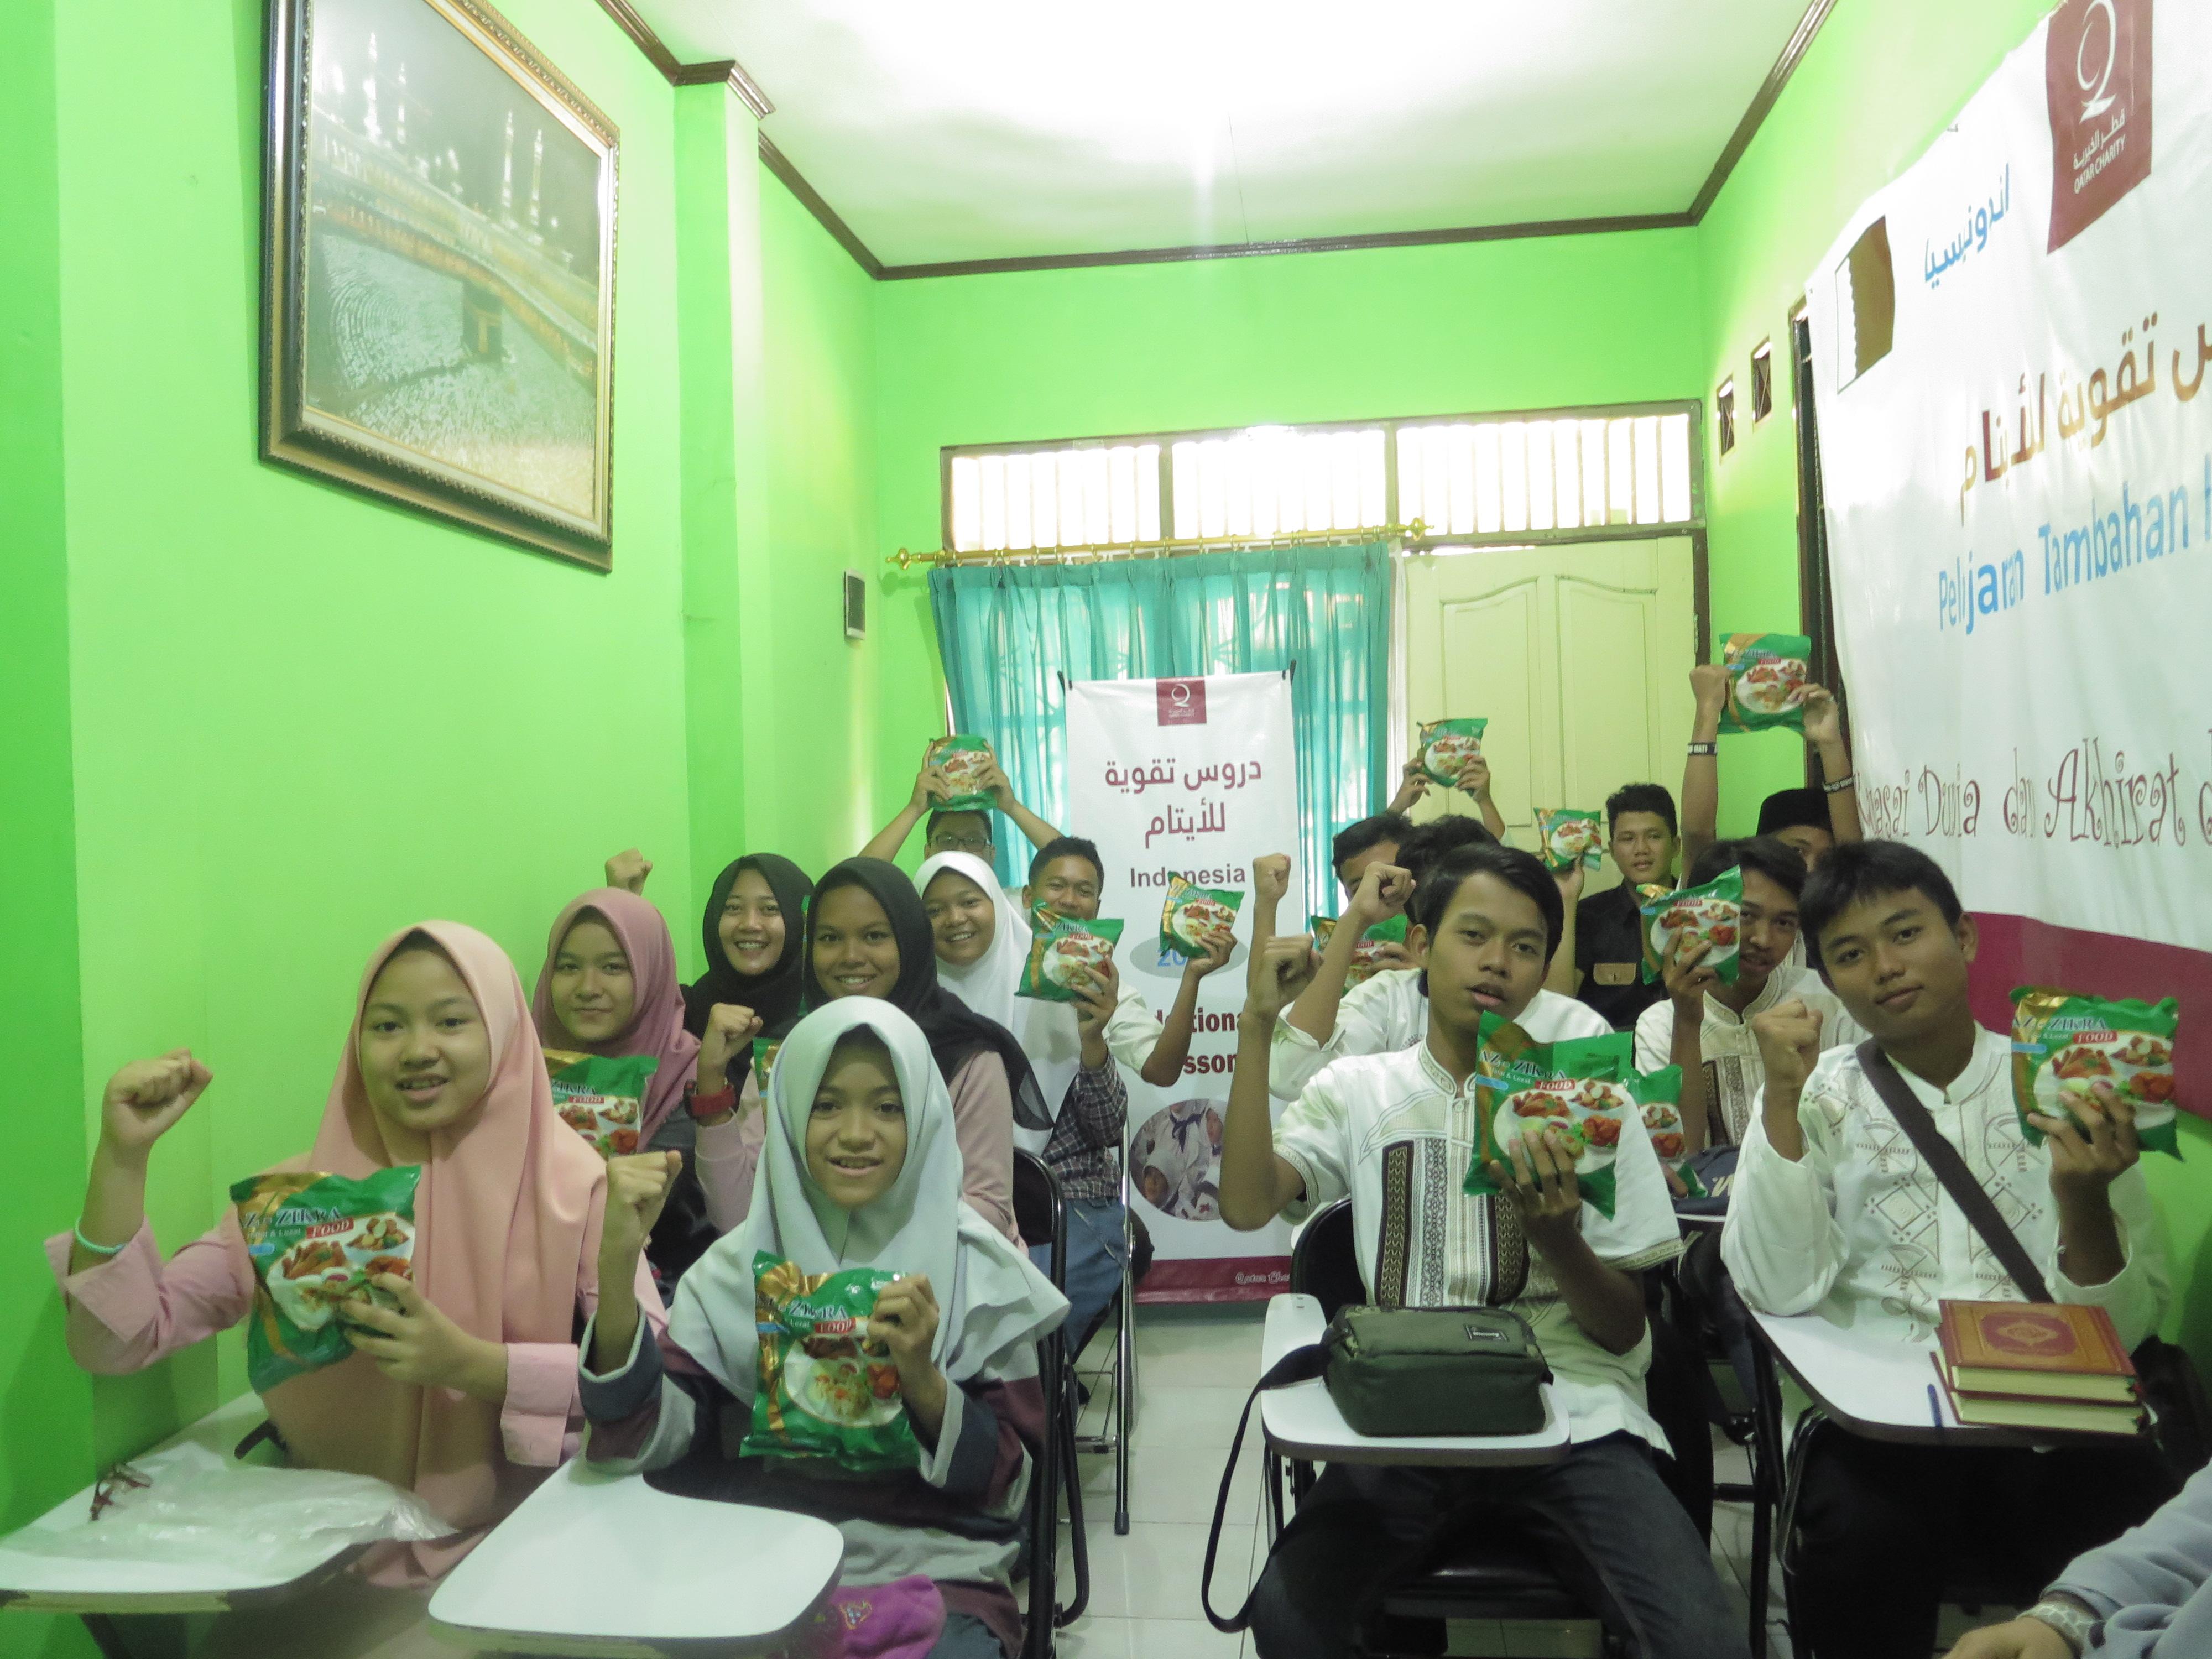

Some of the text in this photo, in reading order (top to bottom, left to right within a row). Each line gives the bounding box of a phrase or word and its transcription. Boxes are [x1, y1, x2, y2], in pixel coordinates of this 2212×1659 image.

[2074, 133, 2126, 194] QATAR CHARITY
[2038, 480, 2189, 597] Tambahan
[1105, 758, 1262, 794] دروس تقوية
[2044, 735, 2185, 849] Akhirat
[1144, 797, 1226, 850] للأيتام
[1130, 863, 1246, 888] Indnesia
[1538, 1080, 1572, 1090] FOOD
[311, 1219, 350, 1239] FOOD
